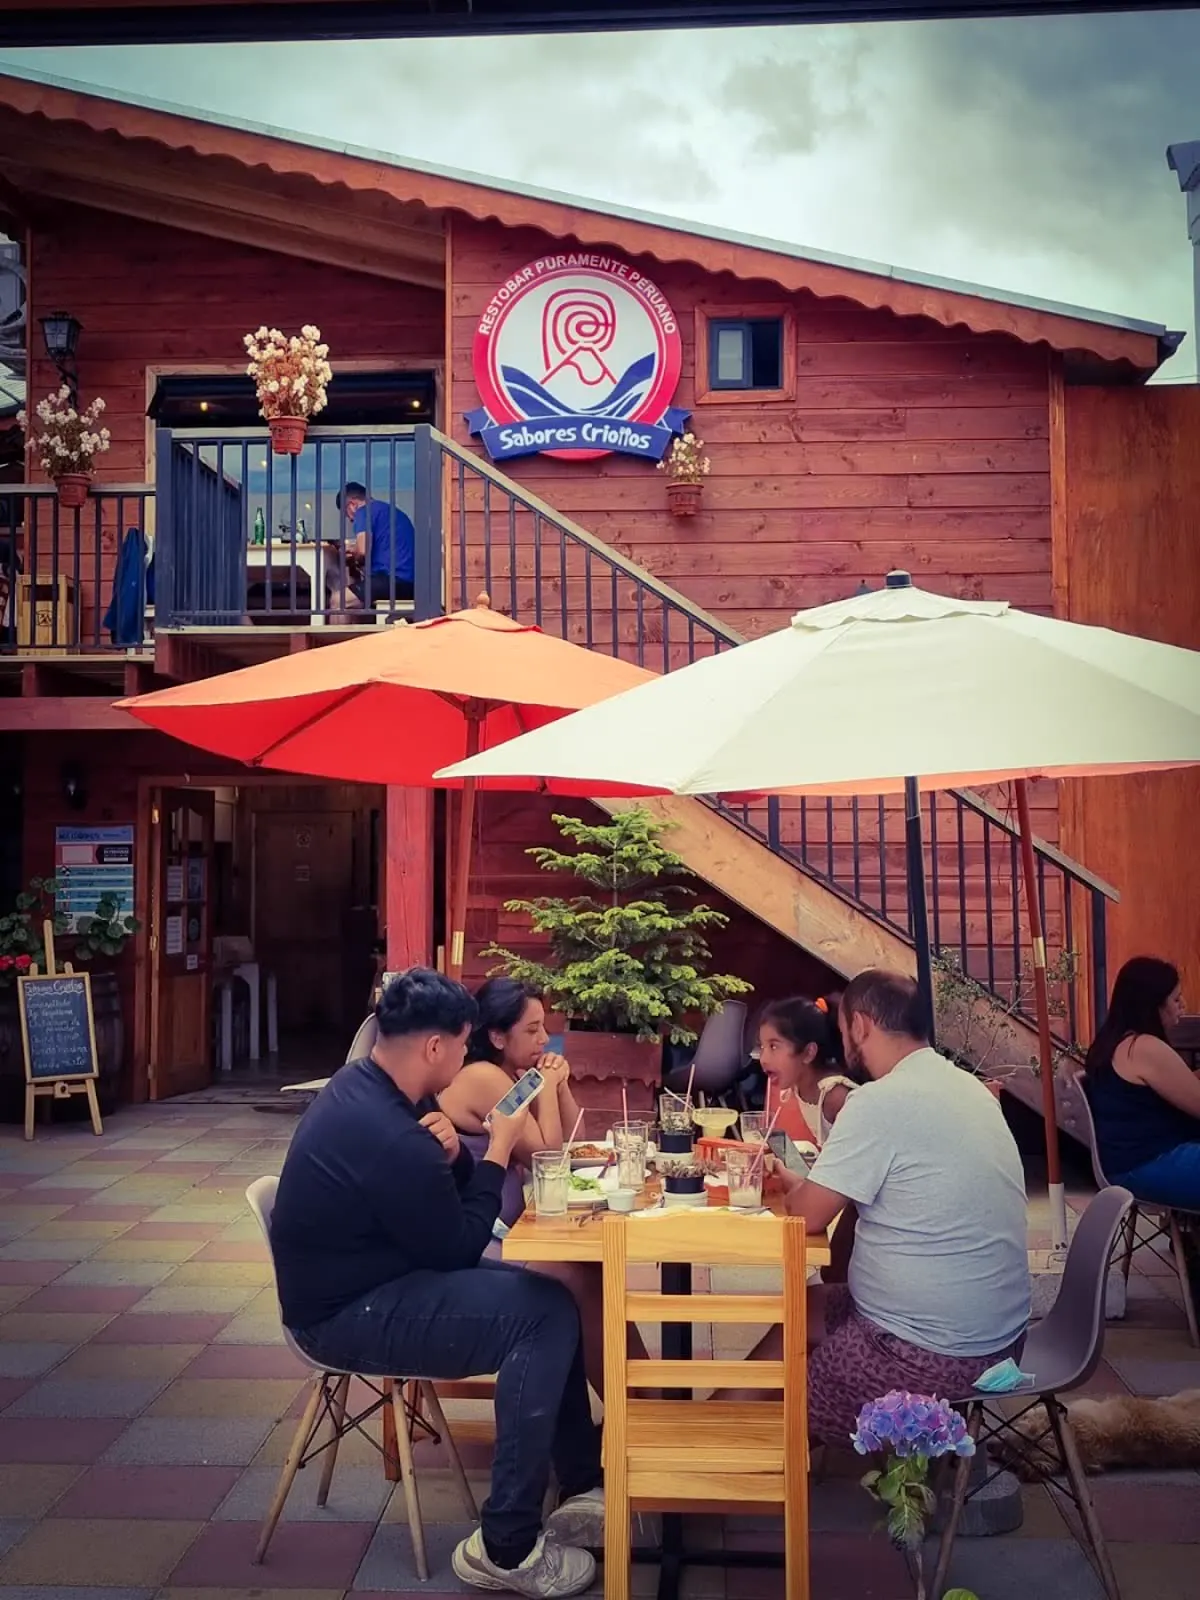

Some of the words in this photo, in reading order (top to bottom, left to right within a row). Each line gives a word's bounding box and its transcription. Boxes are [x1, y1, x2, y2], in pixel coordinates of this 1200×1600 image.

[478, 267, 535, 335] RESTOBAR
[535, 253, 627, 278] PURAMENTE
[628, 271, 676, 335] PERUANO
[500, 426, 577, 450] Sabores
[581, 422, 652, 449] Criollos
